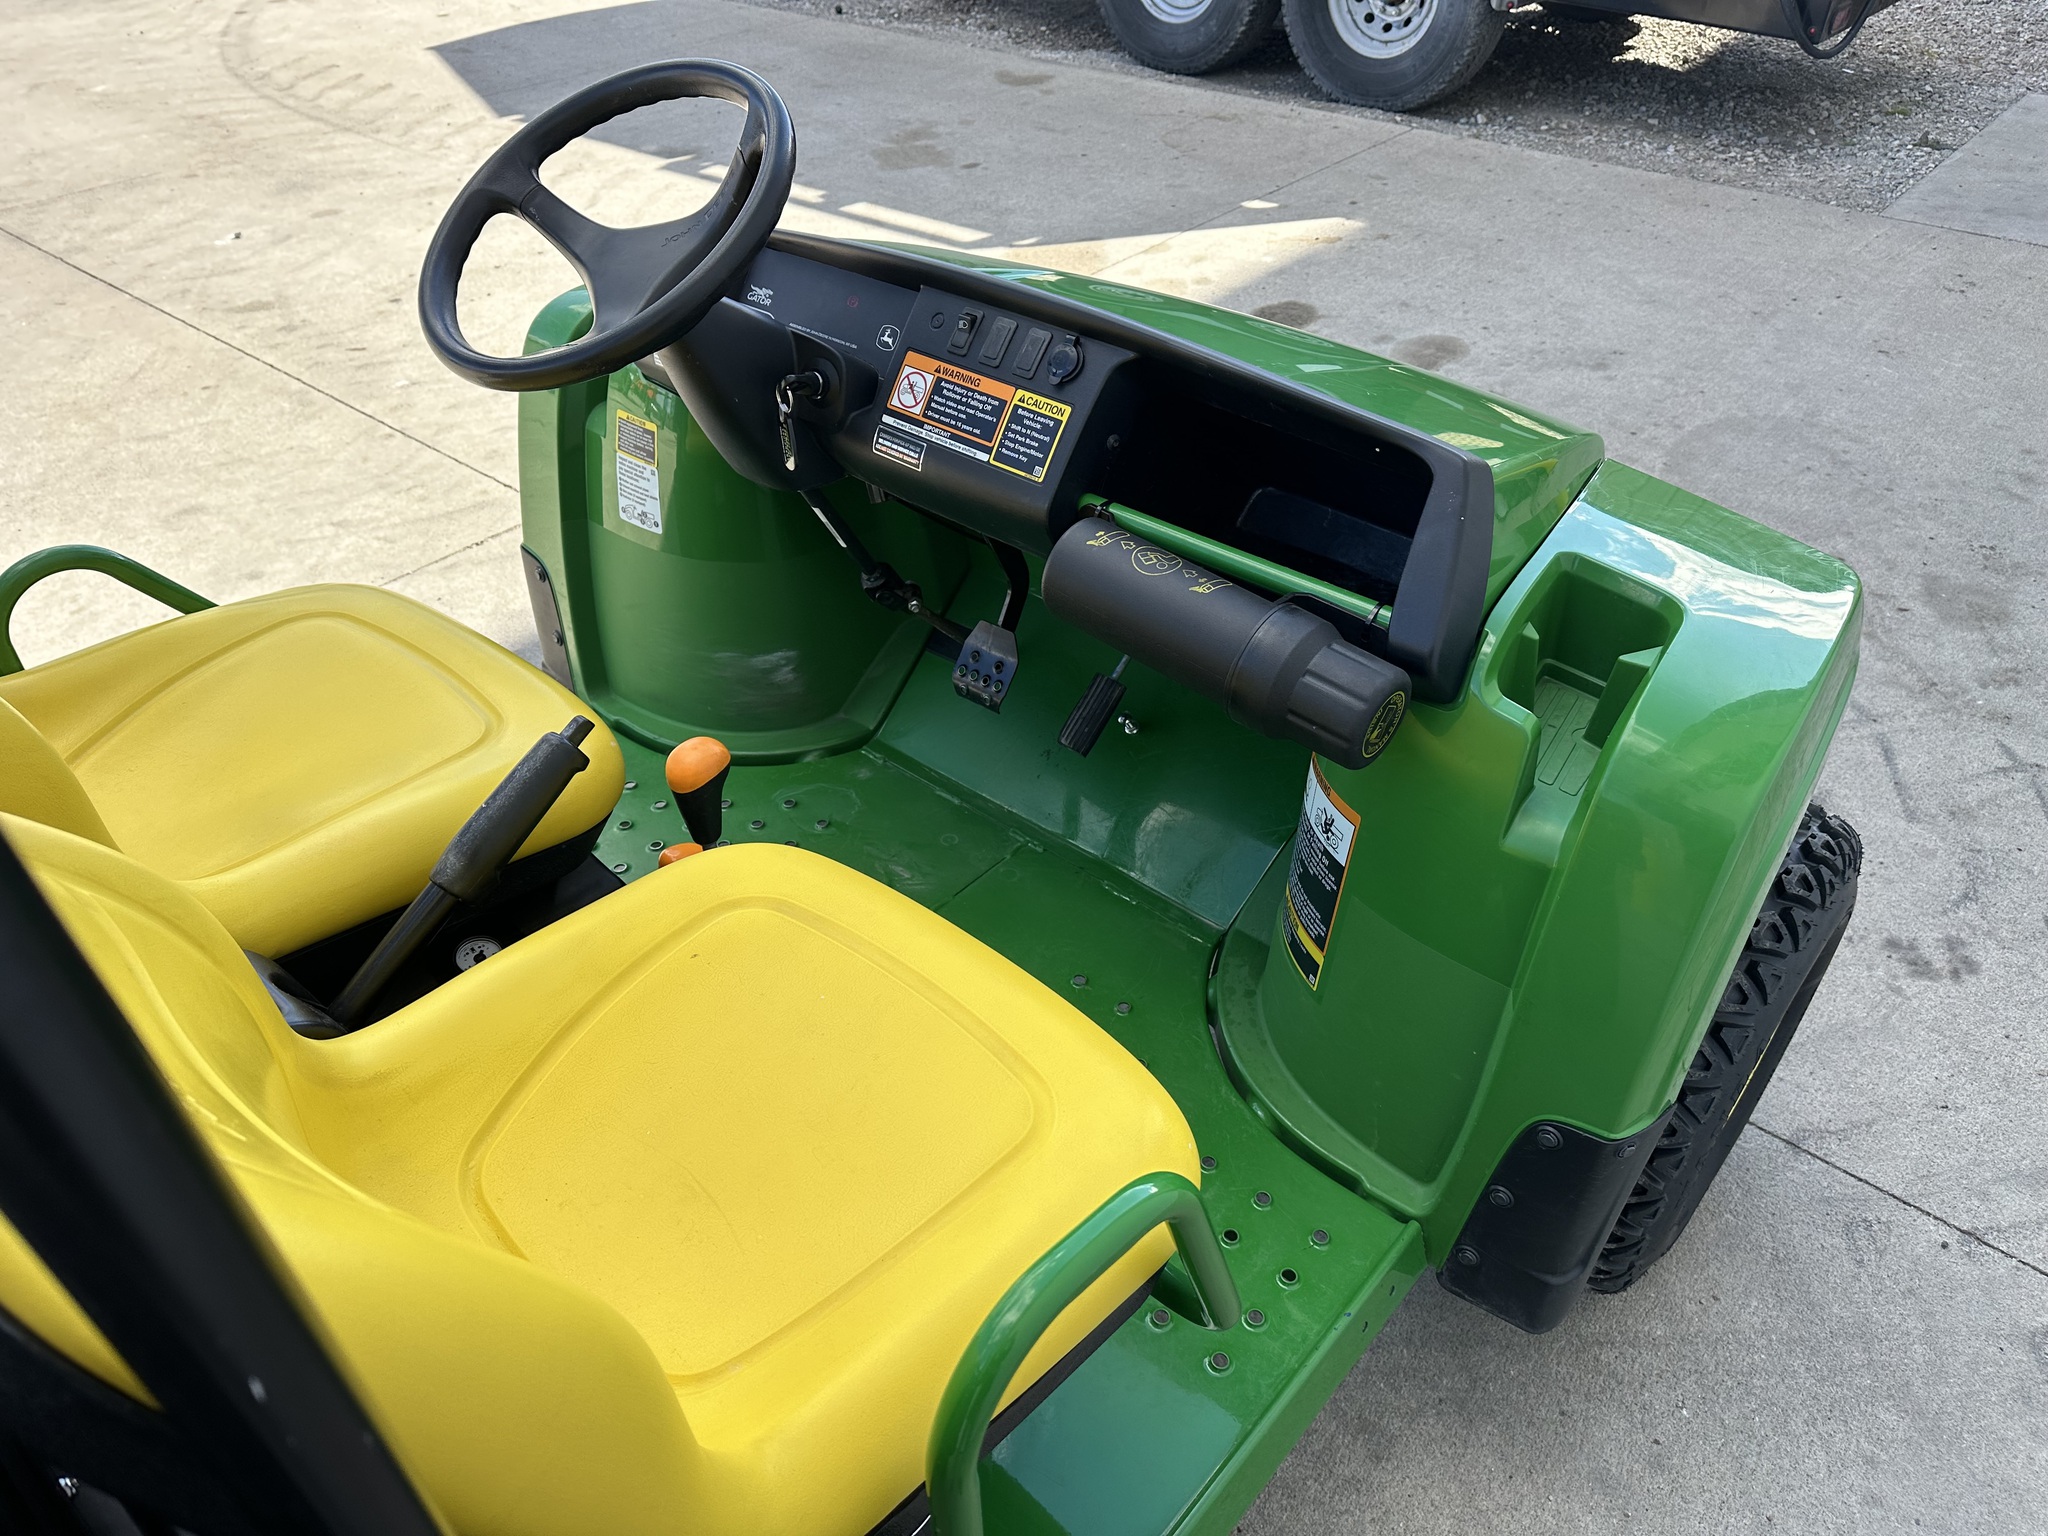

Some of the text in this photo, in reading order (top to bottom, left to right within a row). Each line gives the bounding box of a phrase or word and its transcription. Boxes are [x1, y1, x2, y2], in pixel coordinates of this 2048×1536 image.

[747, 292, 772, 306] GATOR
[941, 367, 982, 388] WARNING
[940, 381, 954, 390] Avoid
[953, 386, 968, 395] Injury
[973, 393, 988, 402] Death
[988, 398, 999, 406] from
[942, 389, 962, 400] Rollover
[967, 398, 984, 409] Falling
[930, 402, 945, 411] Manual
[945, 407, 958, 416] before
[933, 395, 946, 404] Watch
[946, 400, 957, 408] video
[965, 407, 975, 415] read
[974, 411, 997, 423] Operator's
[1025, 396, 1066, 418] CAUTION
[629, 415, 646, 426] CAUTION
[927, 411, 940, 419] Driver
[961, 424, 973, 432] years
[1017, 408, 1055, 428] Before Leaving
[1023, 418, 1043, 430] Vehicle:
[893, 420, 907, 429] Prevent
[924, 432, 934, 440] Stop
[935, 436, 948, 444] vehicle
[948, 441, 961, 449] before
[923, 423, 951, 438] IMPORTANT
[1007, 431, 1039, 447] Set Park Brake
[1010, 423, 1021, 431] Shift
[1030, 431, 1050, 443] (Neutral)
[1001, 448, 1028, 463] Remove Key
[1004, 440, 1044, 460] Stop Engine/Motor
[1321, 855, 1329, 866] Off
